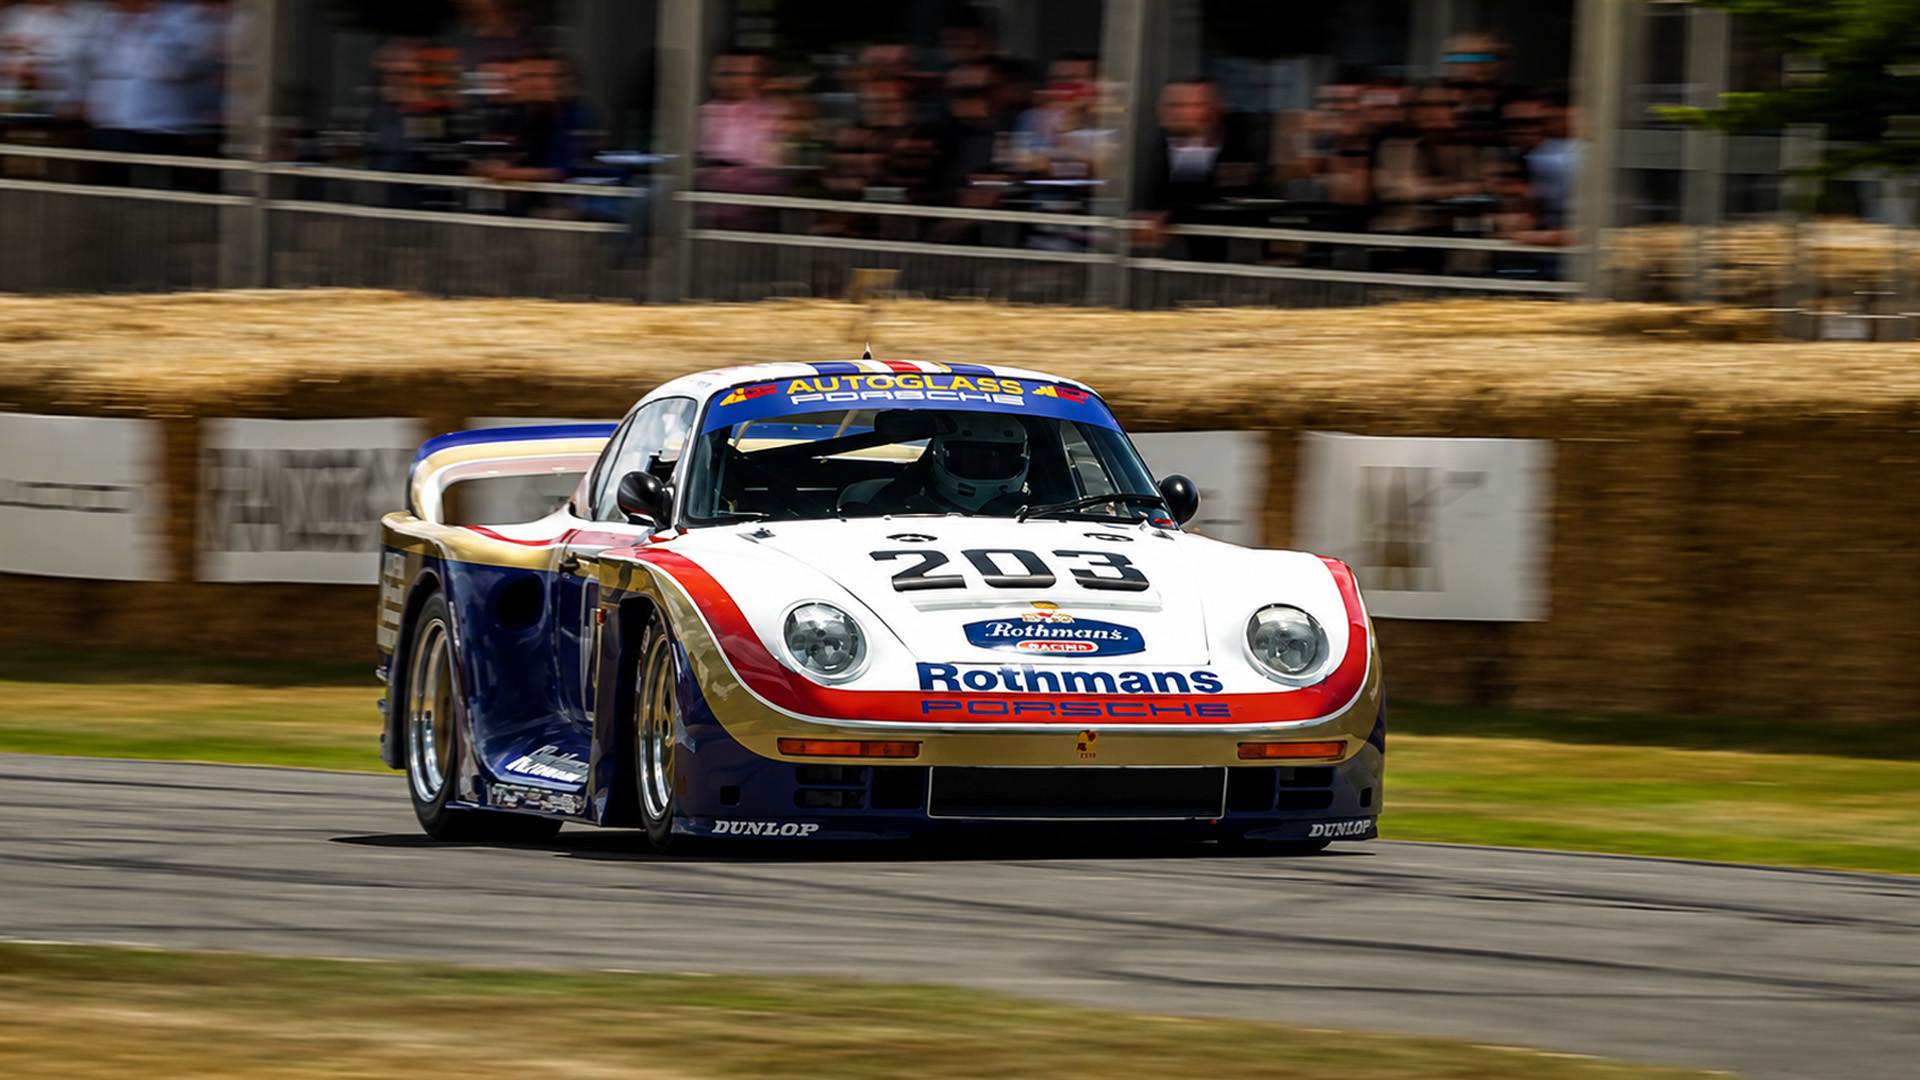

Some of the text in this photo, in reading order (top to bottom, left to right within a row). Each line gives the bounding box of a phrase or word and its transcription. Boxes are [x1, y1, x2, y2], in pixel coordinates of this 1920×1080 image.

[787, 374, 1024, 395] AUTOGLASS
[790, 390, 1025, 406] PORSCHE
[869, 549, 1150, 592] 203
[916, 662, 1224, 694] Rothmans
[921, 700, 1232, 718] PORSCHE
[712, 820, 819, 837] DUNLOP
[1308, 820, 1371, 837] DUNLOP
